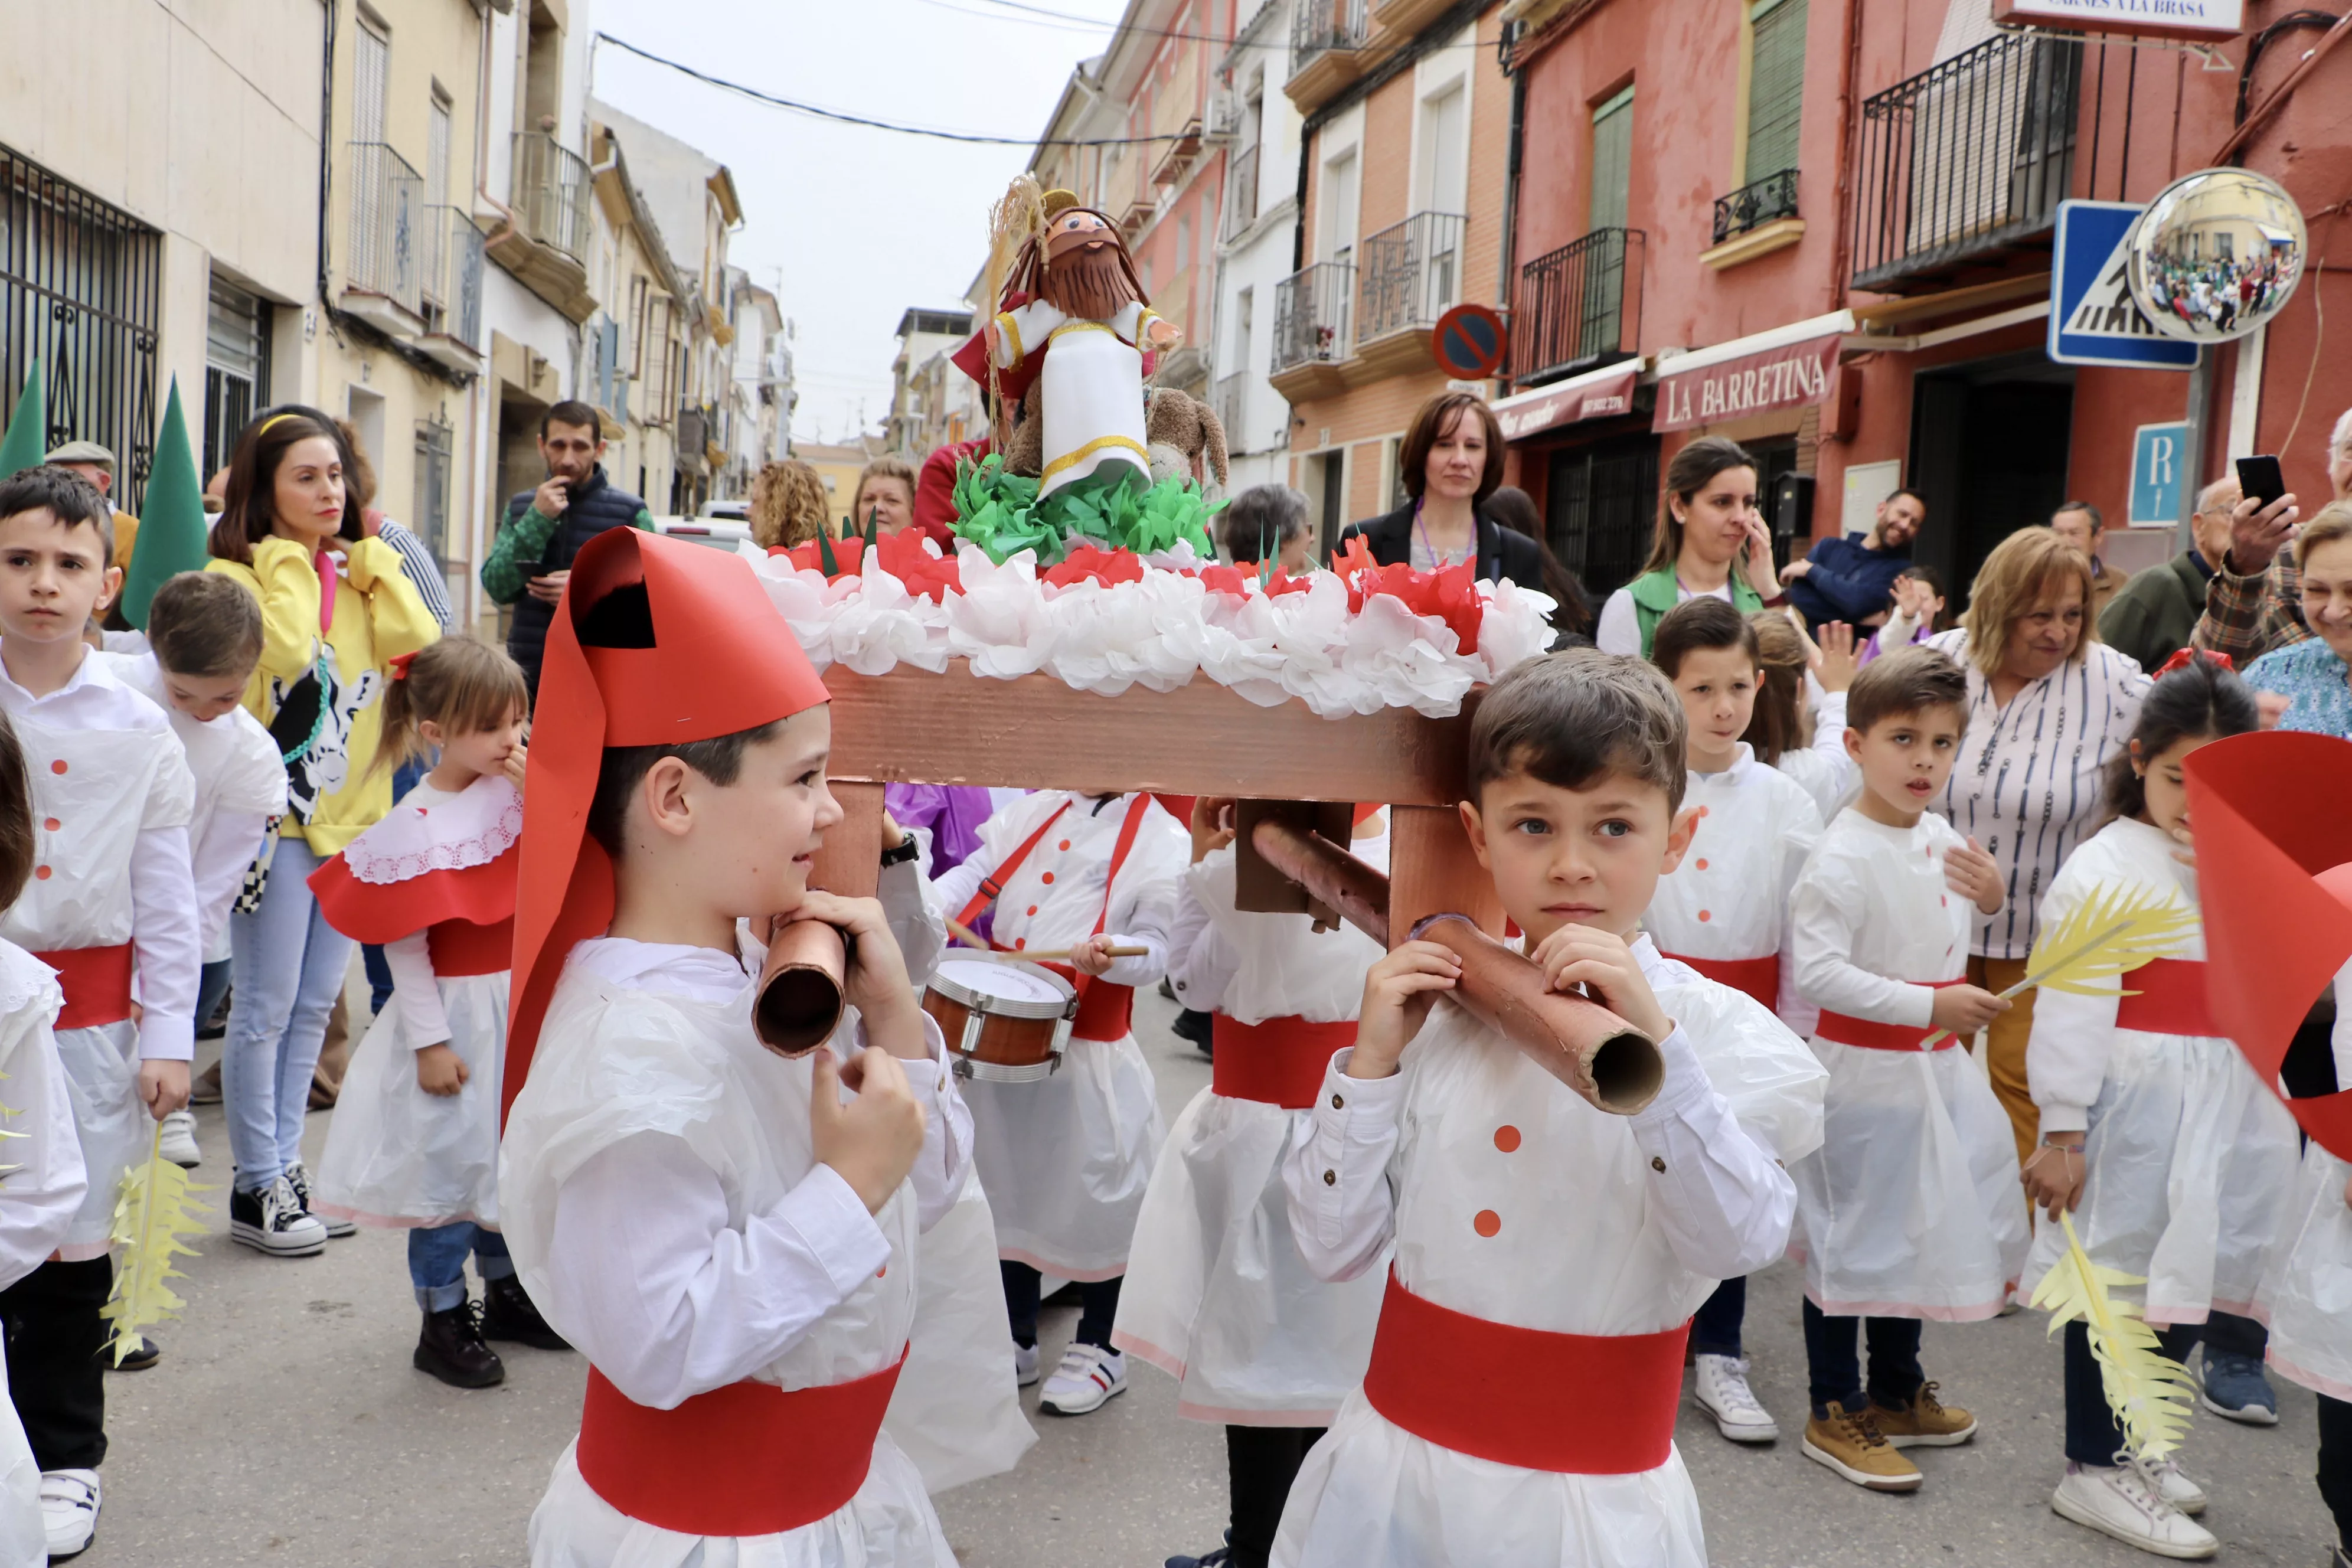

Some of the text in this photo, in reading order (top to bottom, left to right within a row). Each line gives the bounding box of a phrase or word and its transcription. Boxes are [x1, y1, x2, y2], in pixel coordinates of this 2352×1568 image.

[2129, 0, 2148, 12] LA
[2154, 0, 2205, 17] BRASA
[1666, 352, 1826, 424] LA BARRETINA
[2147, 436, 2173, 486] R
